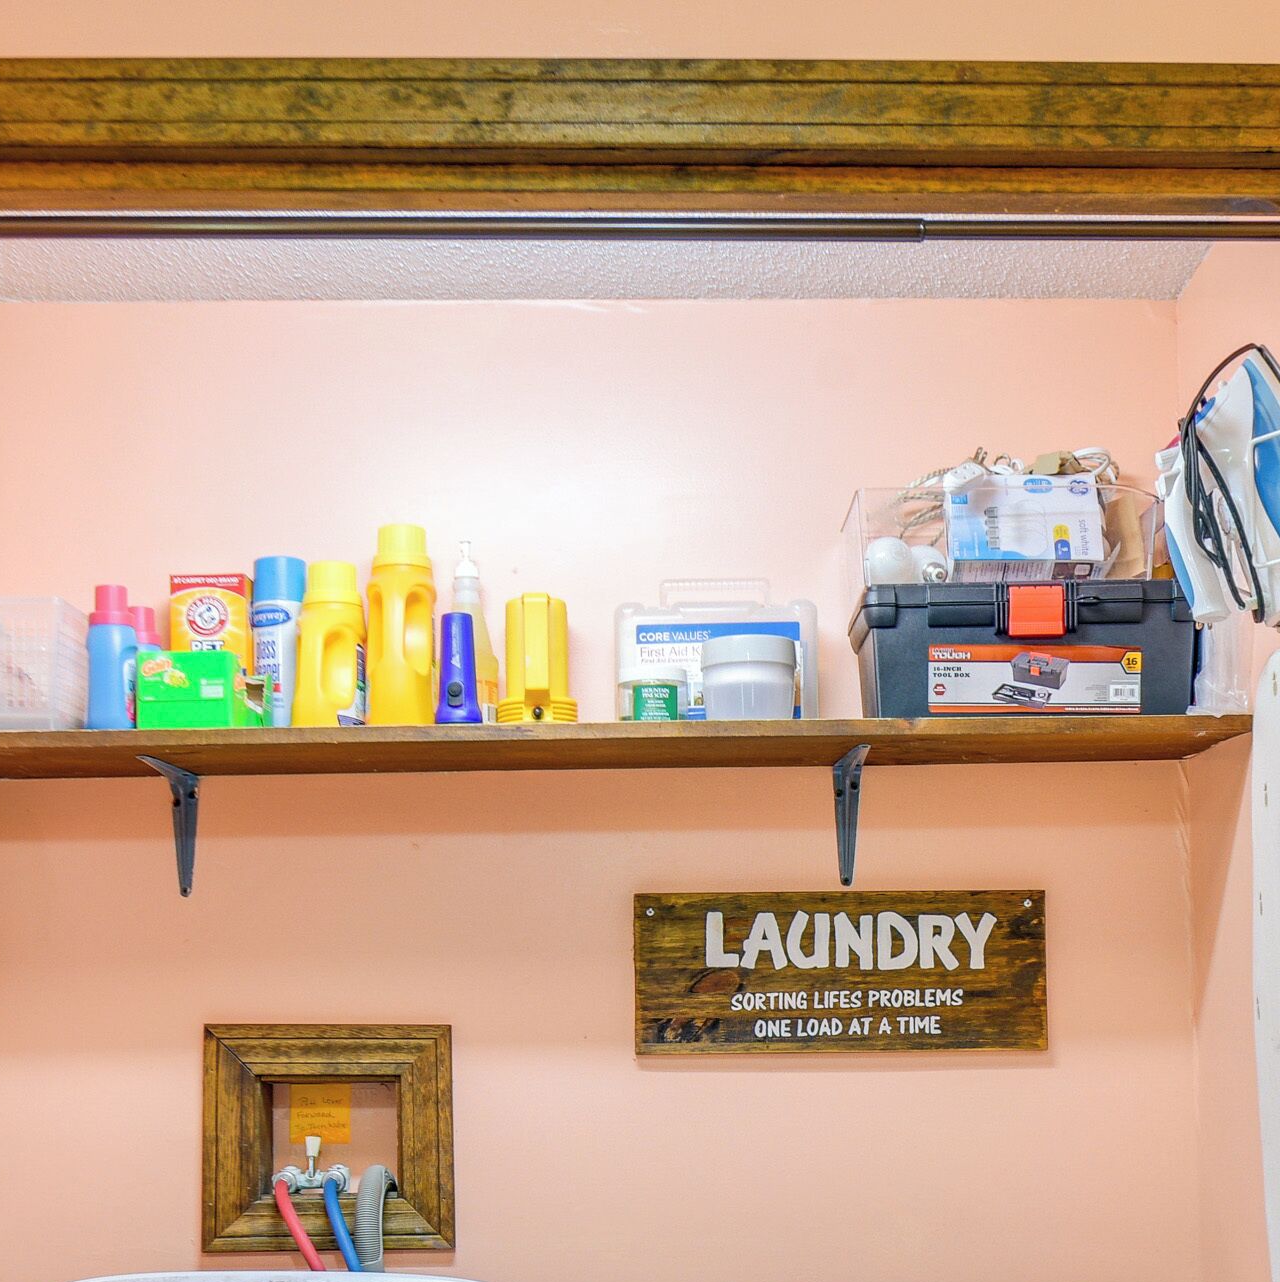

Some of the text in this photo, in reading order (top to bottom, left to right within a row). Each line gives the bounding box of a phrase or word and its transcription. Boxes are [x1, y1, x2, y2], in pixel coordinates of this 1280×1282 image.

[1078, 519, 1090, 556] soft white
[639, 630, 709, 642] CORE VALUES
[191, 640, 225, 652] PET
[640, 646, 665, 658] First
[669, 646, 688, 657] Aid
[932, 651, 971, 660] TOUGH
[1125, 657, 1138, 666] 16
[705, 910, 998, 971] LAUNDRY
[730, 988, 964, 1012] SORTING LIFES PROBLEMS
[754, 1015, 942, 1038] ONE LOAD AT A TIME
